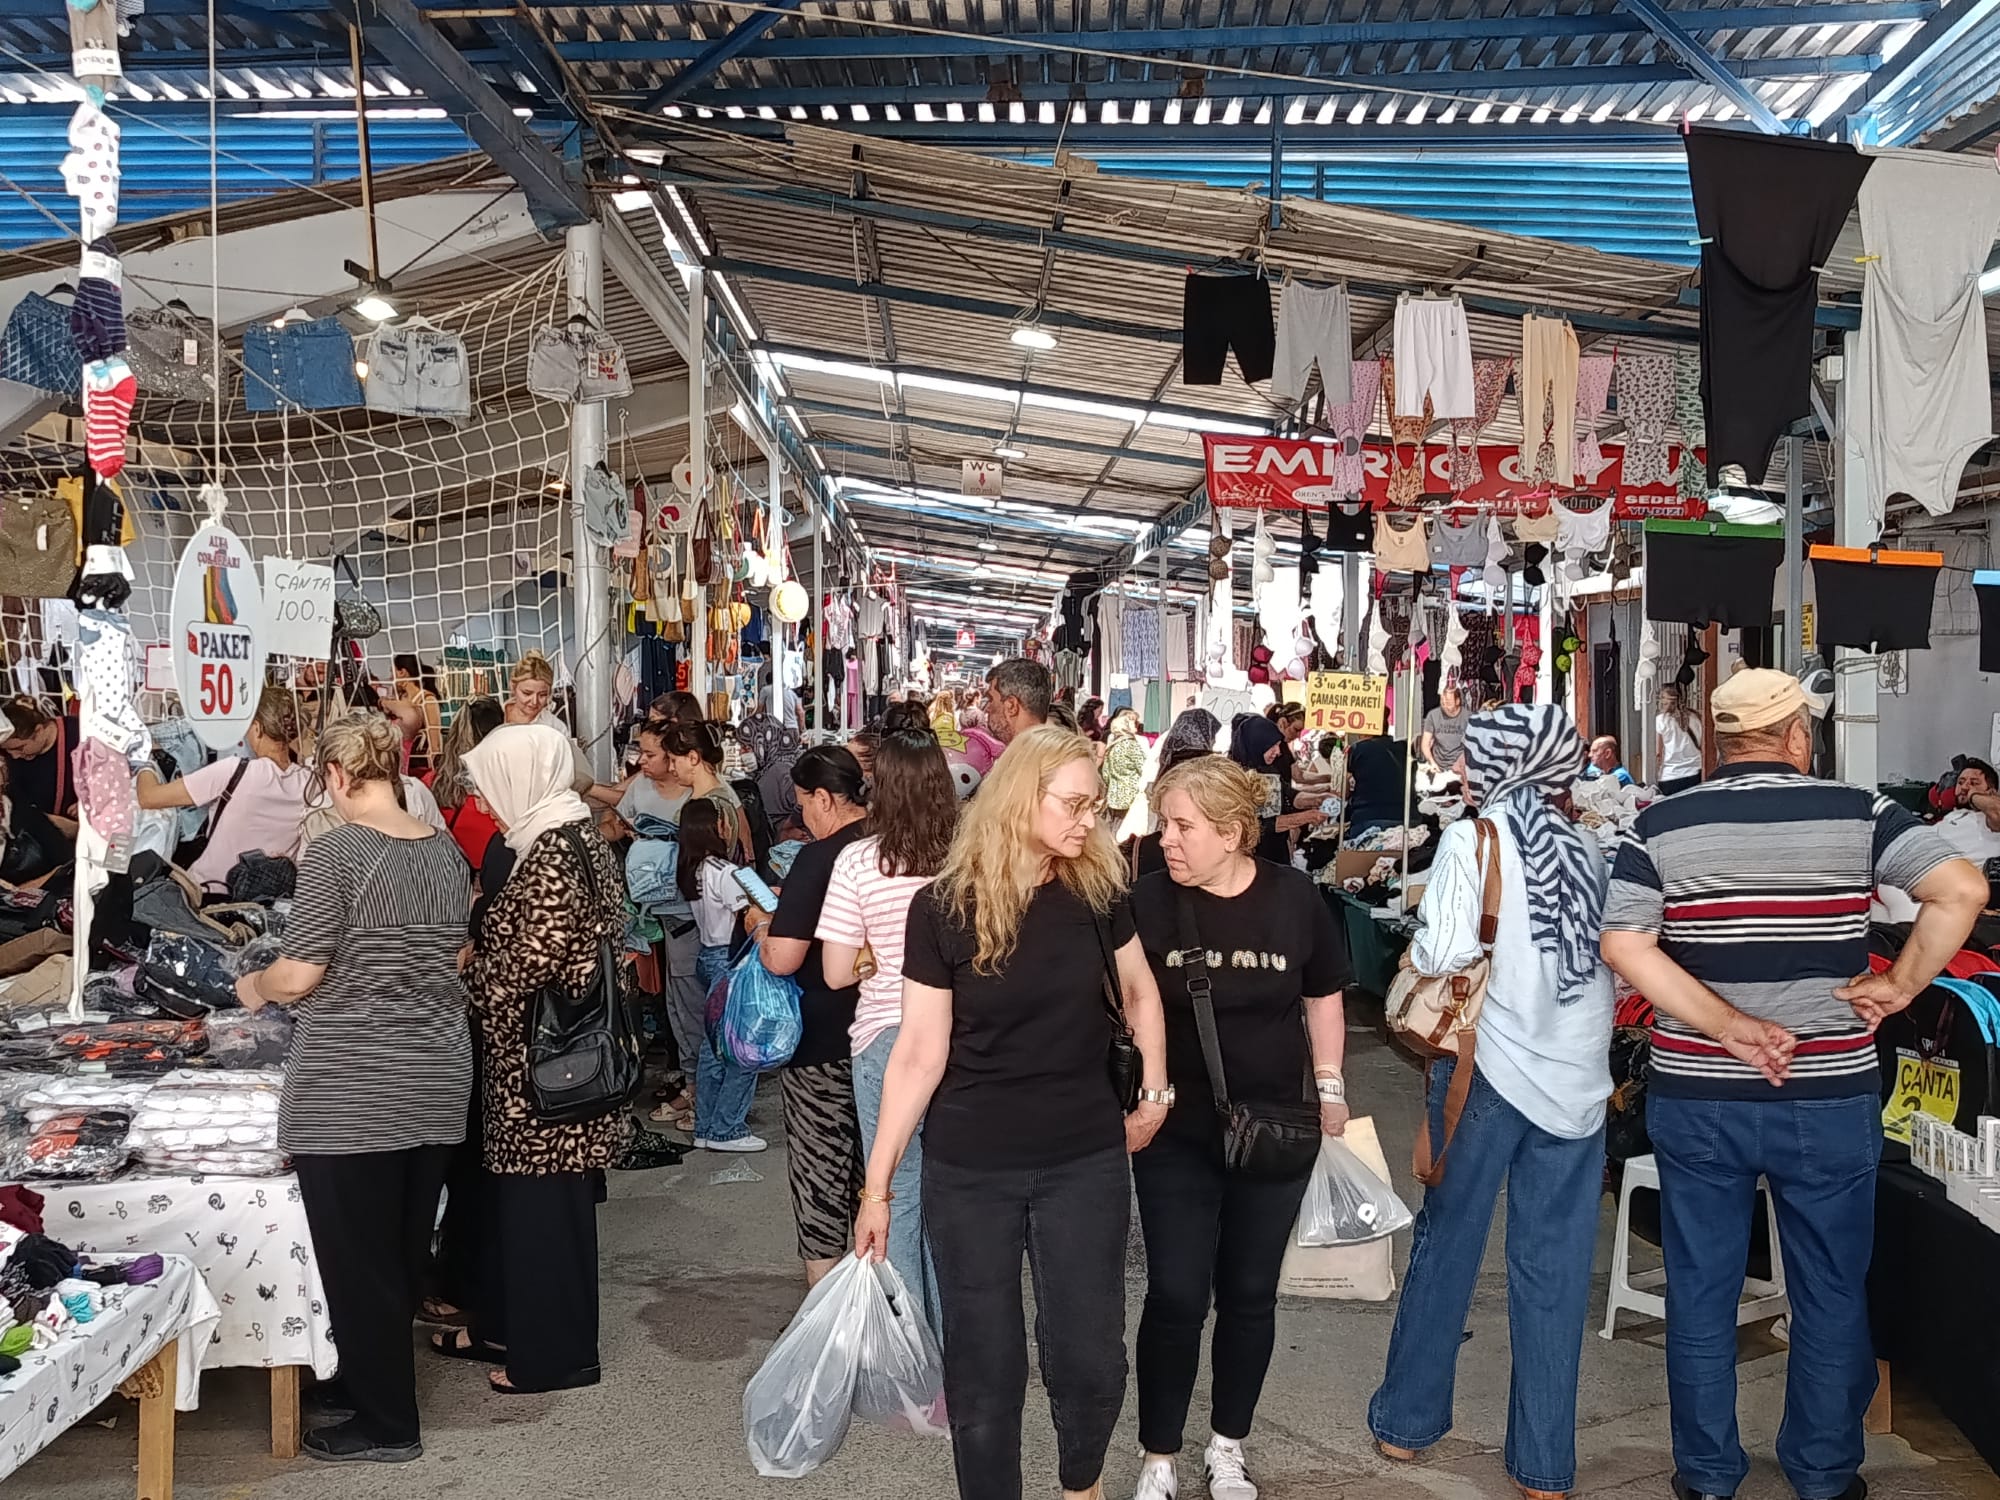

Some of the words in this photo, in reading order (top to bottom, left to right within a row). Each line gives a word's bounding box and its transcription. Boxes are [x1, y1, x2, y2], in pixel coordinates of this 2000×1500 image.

[970, 461, 995, 471] WC
[1213, 443, 1389, 478] EMİR
[1629, 506, 1685, 516] YILDIZI
[274, 573, 331, 593] ÇANTA
[275, 599, 315, 622] 100
[199, 631, 251, 660] PAKET
[200, 663, 233, 716] 50
[1310, 693, 1348, 708] ÇAMAŞIR
[1350, 695, 1381, 709] PAKETİ
[1311, 709, 1366, 730] 150
[1366, 722, 1379, 730] TL
[1900, 1063, 1954, 1102] ÇANTA
